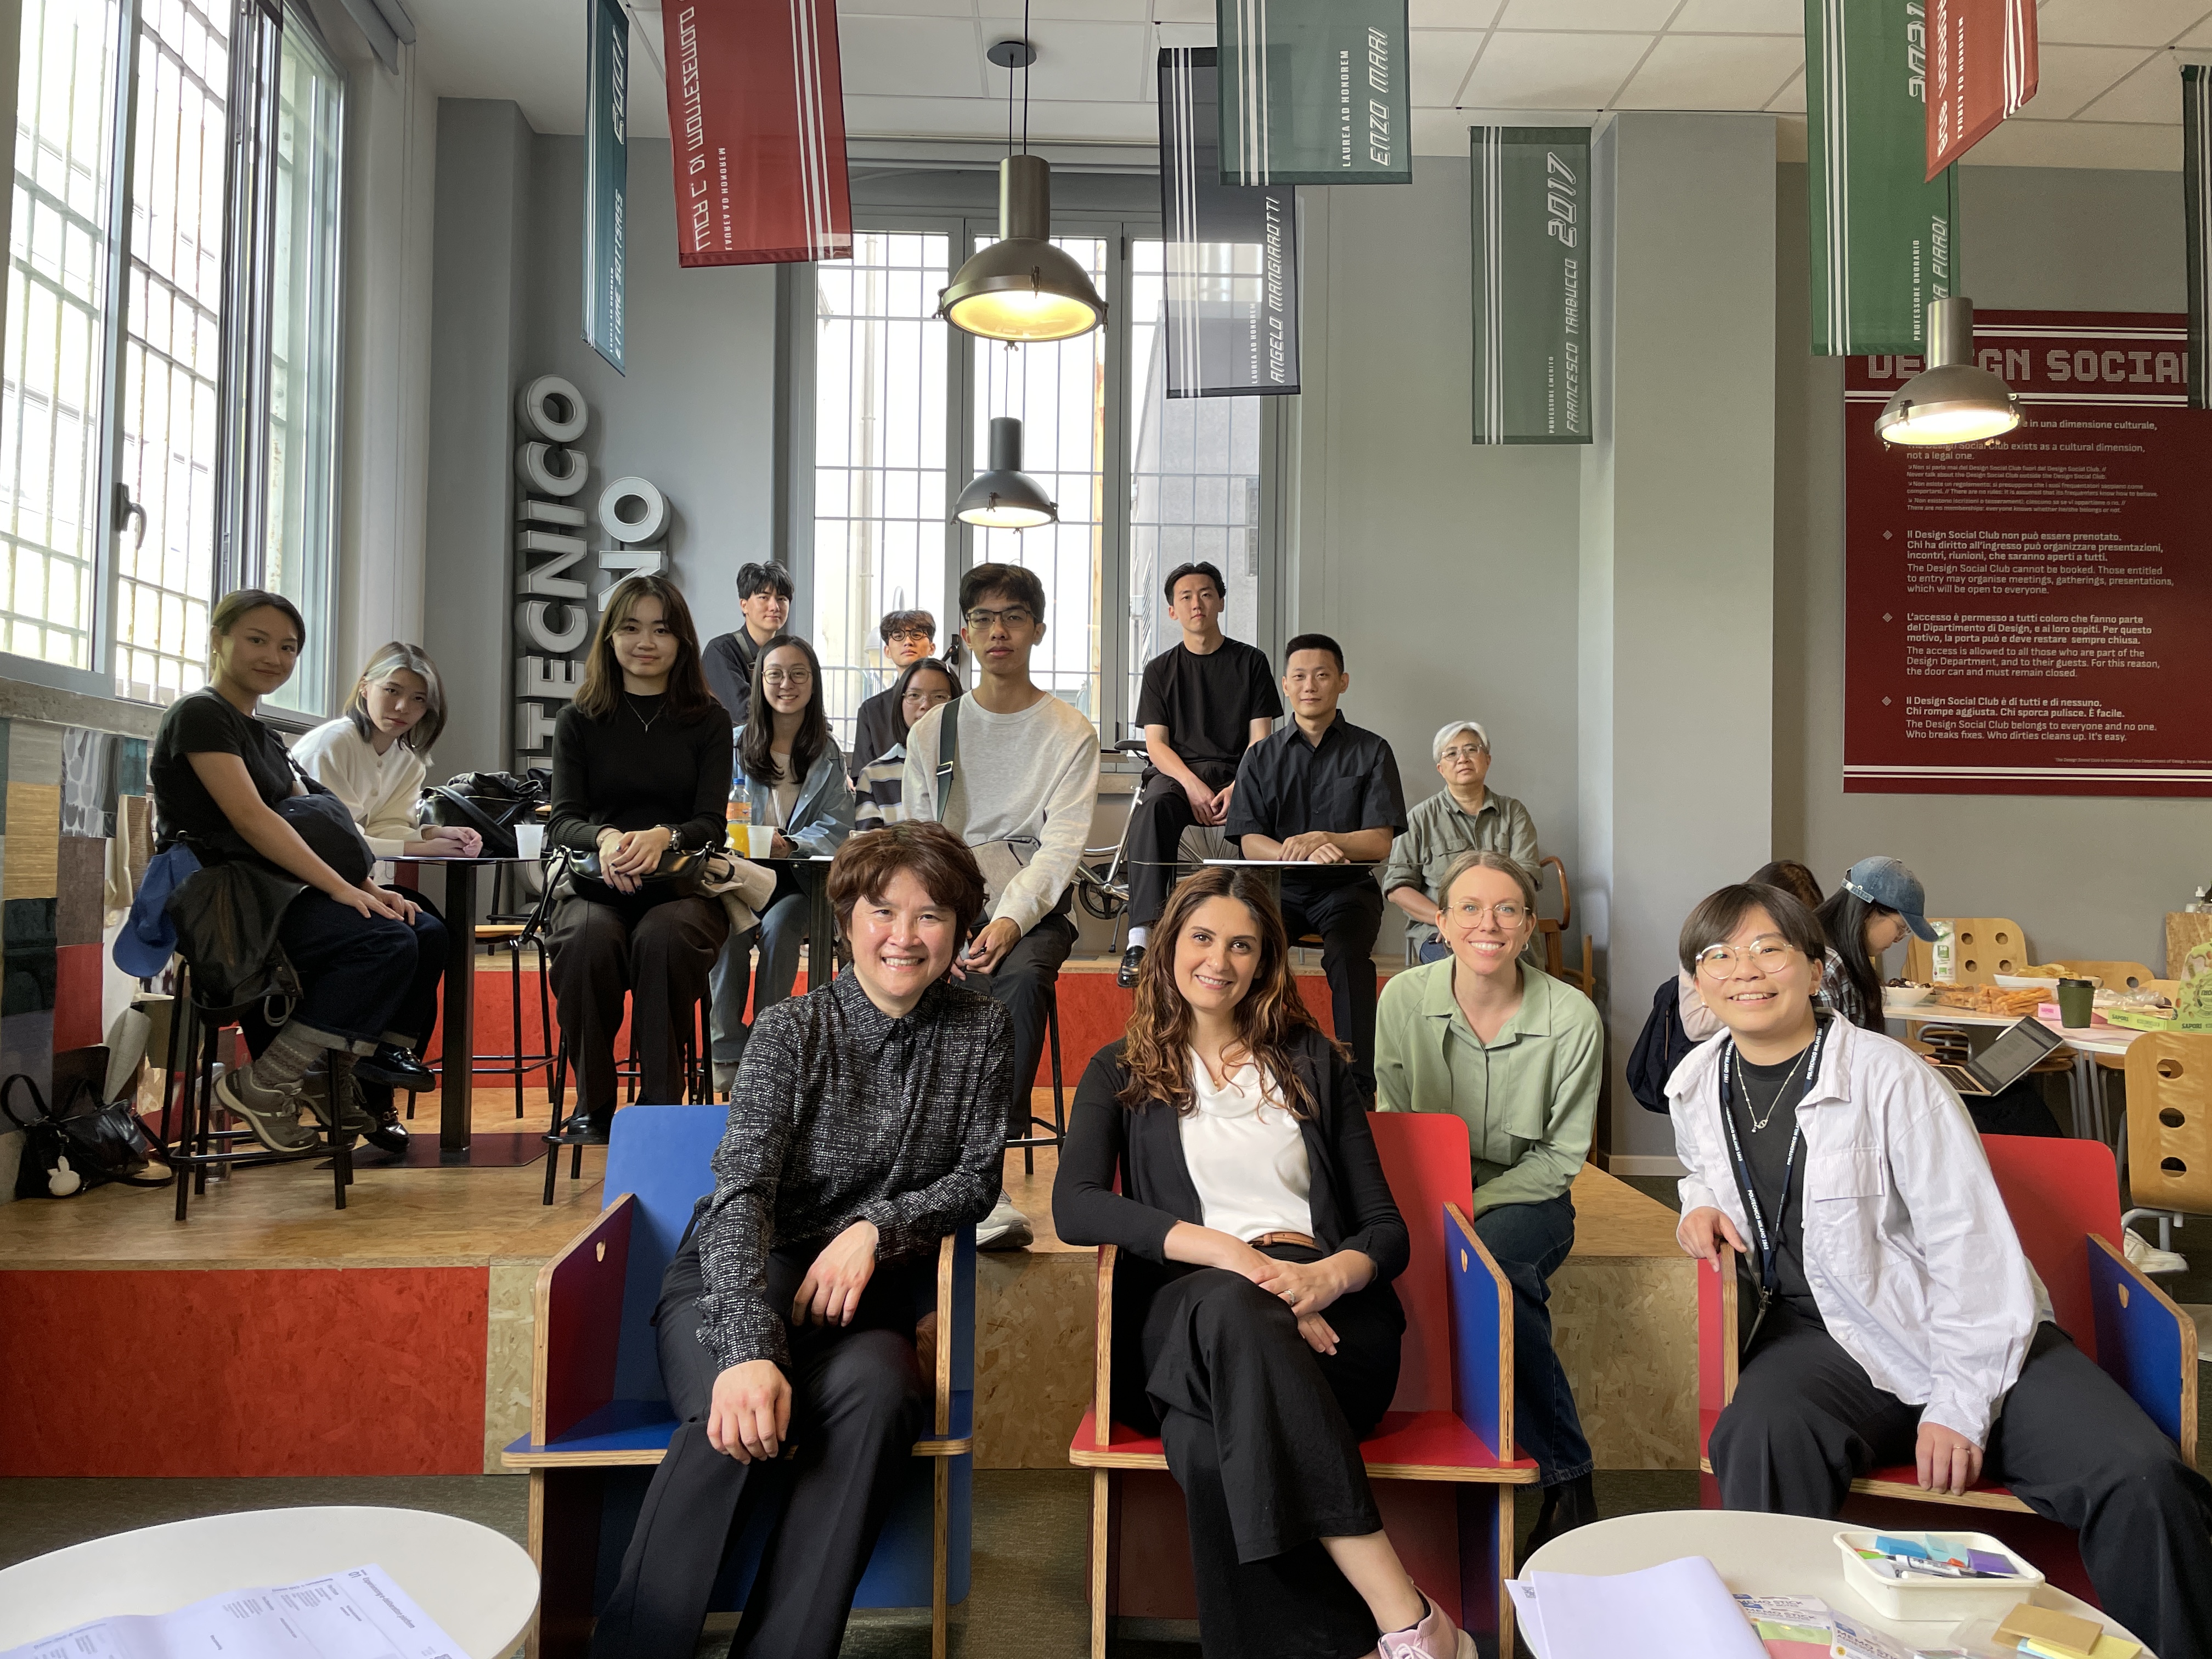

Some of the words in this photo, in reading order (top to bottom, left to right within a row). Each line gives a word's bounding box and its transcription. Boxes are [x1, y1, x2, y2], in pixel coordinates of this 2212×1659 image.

[1368, 26, 1389, 93] MARI
[612, 24, 625, 145] 2001
[1340, 50, 1350, 103] HONOREM
[1341, 107, 1351, 121] AD
[1341, 126, 1351, 167] LAUREA
[1369, 99, 1391, 166] ENZO
[1547, 151, 1577, 249] 2017
[614, 188, 624, 285] SOTTSASS
[1932, 215, 1948, 279] PIARDI
[1265, 196, 1283, 312] MANGIAROTTI
[1912, 239, 1921, 284] ONORARIO
[1564, 258, 1579, 335] TRABUCCO
[1250, 341, 1257, 352] AD
[1269, 316, 1285, 384] ANGELO
[1867, 348, 2030, 381] DEGN
[2046, 349, 2188, 383] SOCIA
[1565, 342, 1579, 434] FRANCESCO
[2114, 421, 2157, 430] culturale,
[1932, 452, 1953, 460] legal
[2059, 443, 2094, 451] cultural
[2096, 443, 2145, 452] dimension,
[1907, 530, 1912, 538] Il
[1915, 530, 1946, 540] Design
[1948, 531, 1977, 539] Social
[1978, 531, 2000, 539] Club
[2021, 531, 2039, 541] può
[2073, 533, 2121, 542] prenotato.
[1907, 540, 1922, 549] Chi
[1925, 540, 1936, 549] ha
[1938, 541, 1967, 549] diritto
[1970, 541, 2022, 551] all'ingresso
[2024, 541, 2041, 551] può
[2043, 542, 2096, 552] organizzare
[2098, 543, 2163, 553] presentazioni,
[1907, 550, 1946, 560] incontri,
[1949, 551, 1987, 561] riunioni,
[1989, 552, 2006, 560] che
[2047, 552, 2075, 562] aperti
[2084, 552, 2108, 561] tutti.
[1907, 613, 1951, 621] L'accesso
[1954, 613, 1959, 621] è
[1961, 615, 2007, 623] permesso
[2016, 614, 2038, 622] tutti
[2039, 614, 2069, 623] coloro
[2070, 614, 2088, 623] che
[2090, 614, 2117, 623] fanno
[2119, 616, 2143, 625] parte
[1905, 730, 1927, 738] Who
[1929, 730, 1959, 738] breaks
[1961, 730, 1985, 738] fixes.
[1987, 731, 2008, 739] Who
[2010, 731, 2039, 740] dirties
[2041, 732, 2070, 740] cleans
[2089, 732, 2102, 741] It's
[1906, 719, 1923, 728] The
[1926, 720, 1956, 730] Design
[1959, 720, 1986, 729] Social
[1988, 720, 2009, 729] Club
[2011, 721, 2047, 731] belongs
[2061, 723, 2103, 731] everyone
[2104, 722, 2122, 730] and
[2112, 1014, 2129, 1022] SAPORI
[1731, 1133, 1740, 1152] MILANO
[1786, 1136, 1797, 1165] POLITECNICO
[1747, 1189, 1761, 1220] POLITECNICO
[1757, 1220, 1767, 1239] MILANO
[1784, 1612, 1817, 1621] STICK
[1837, 1630, 1874, 1651] MEMO
